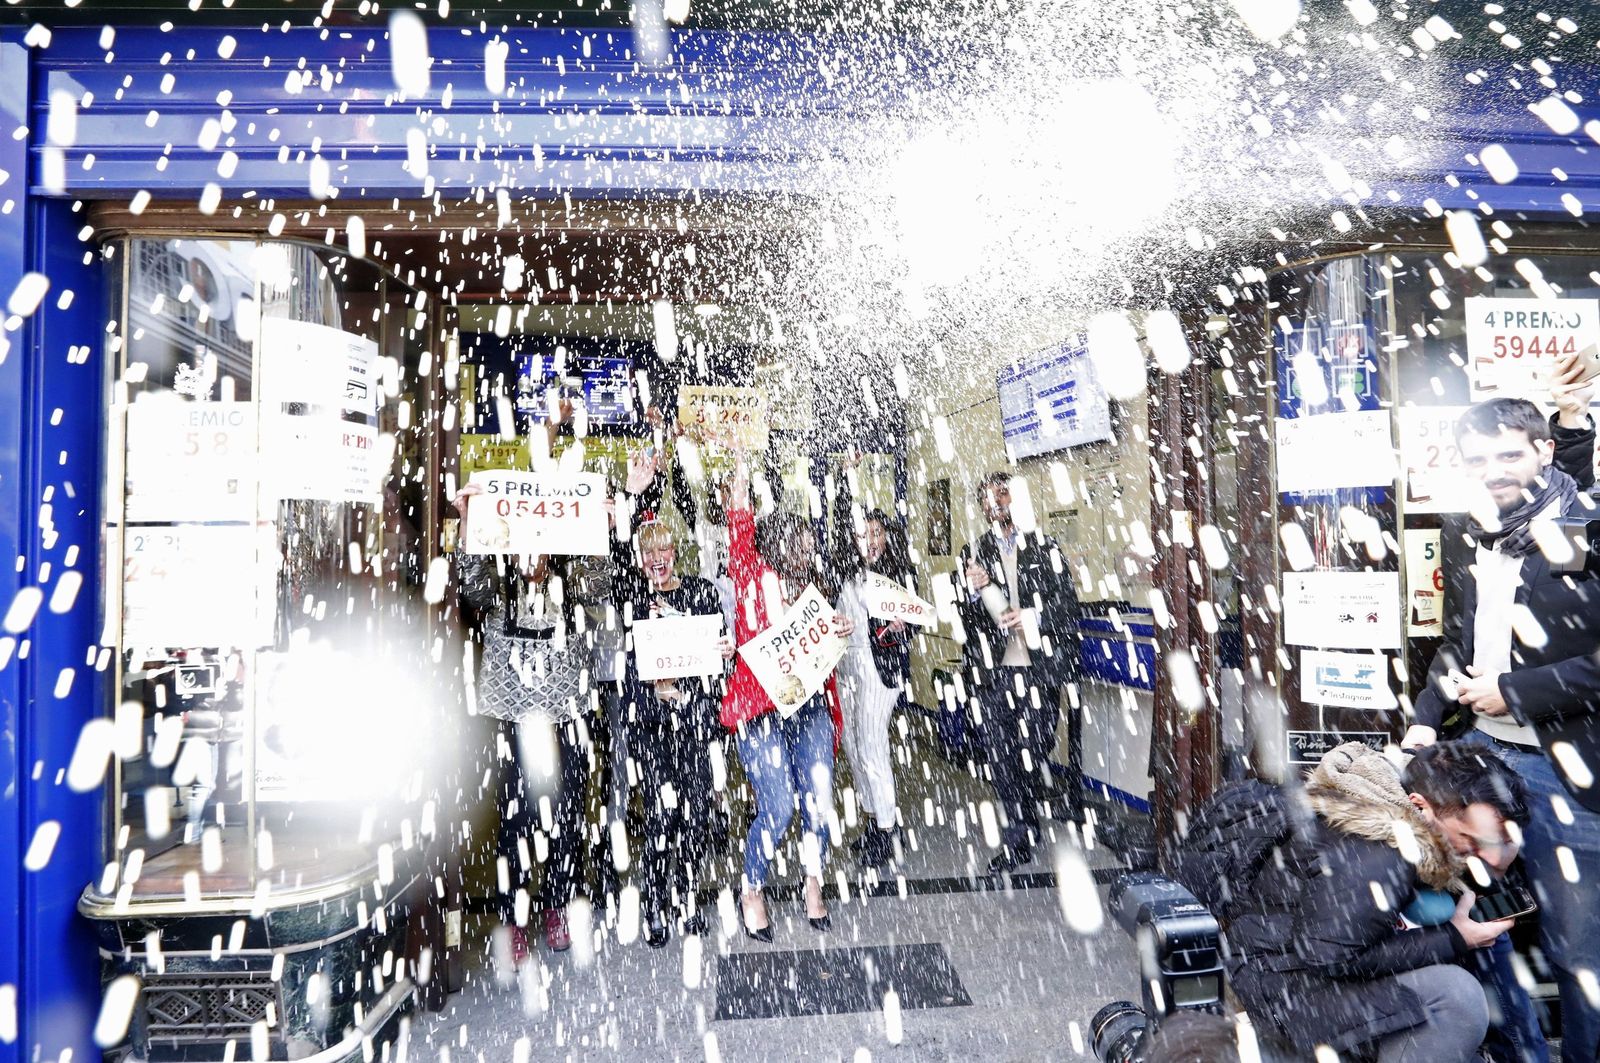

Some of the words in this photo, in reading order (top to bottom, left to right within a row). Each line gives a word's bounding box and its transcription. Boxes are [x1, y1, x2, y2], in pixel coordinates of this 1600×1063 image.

[1493, 335, 1577, 359] 59444
[482, 447, 518, 459] 91917
[505, 481, 592, 497] PREO
[496, 499, 580, 518] 05431
[771, 599, 821, 653] PREMIO
